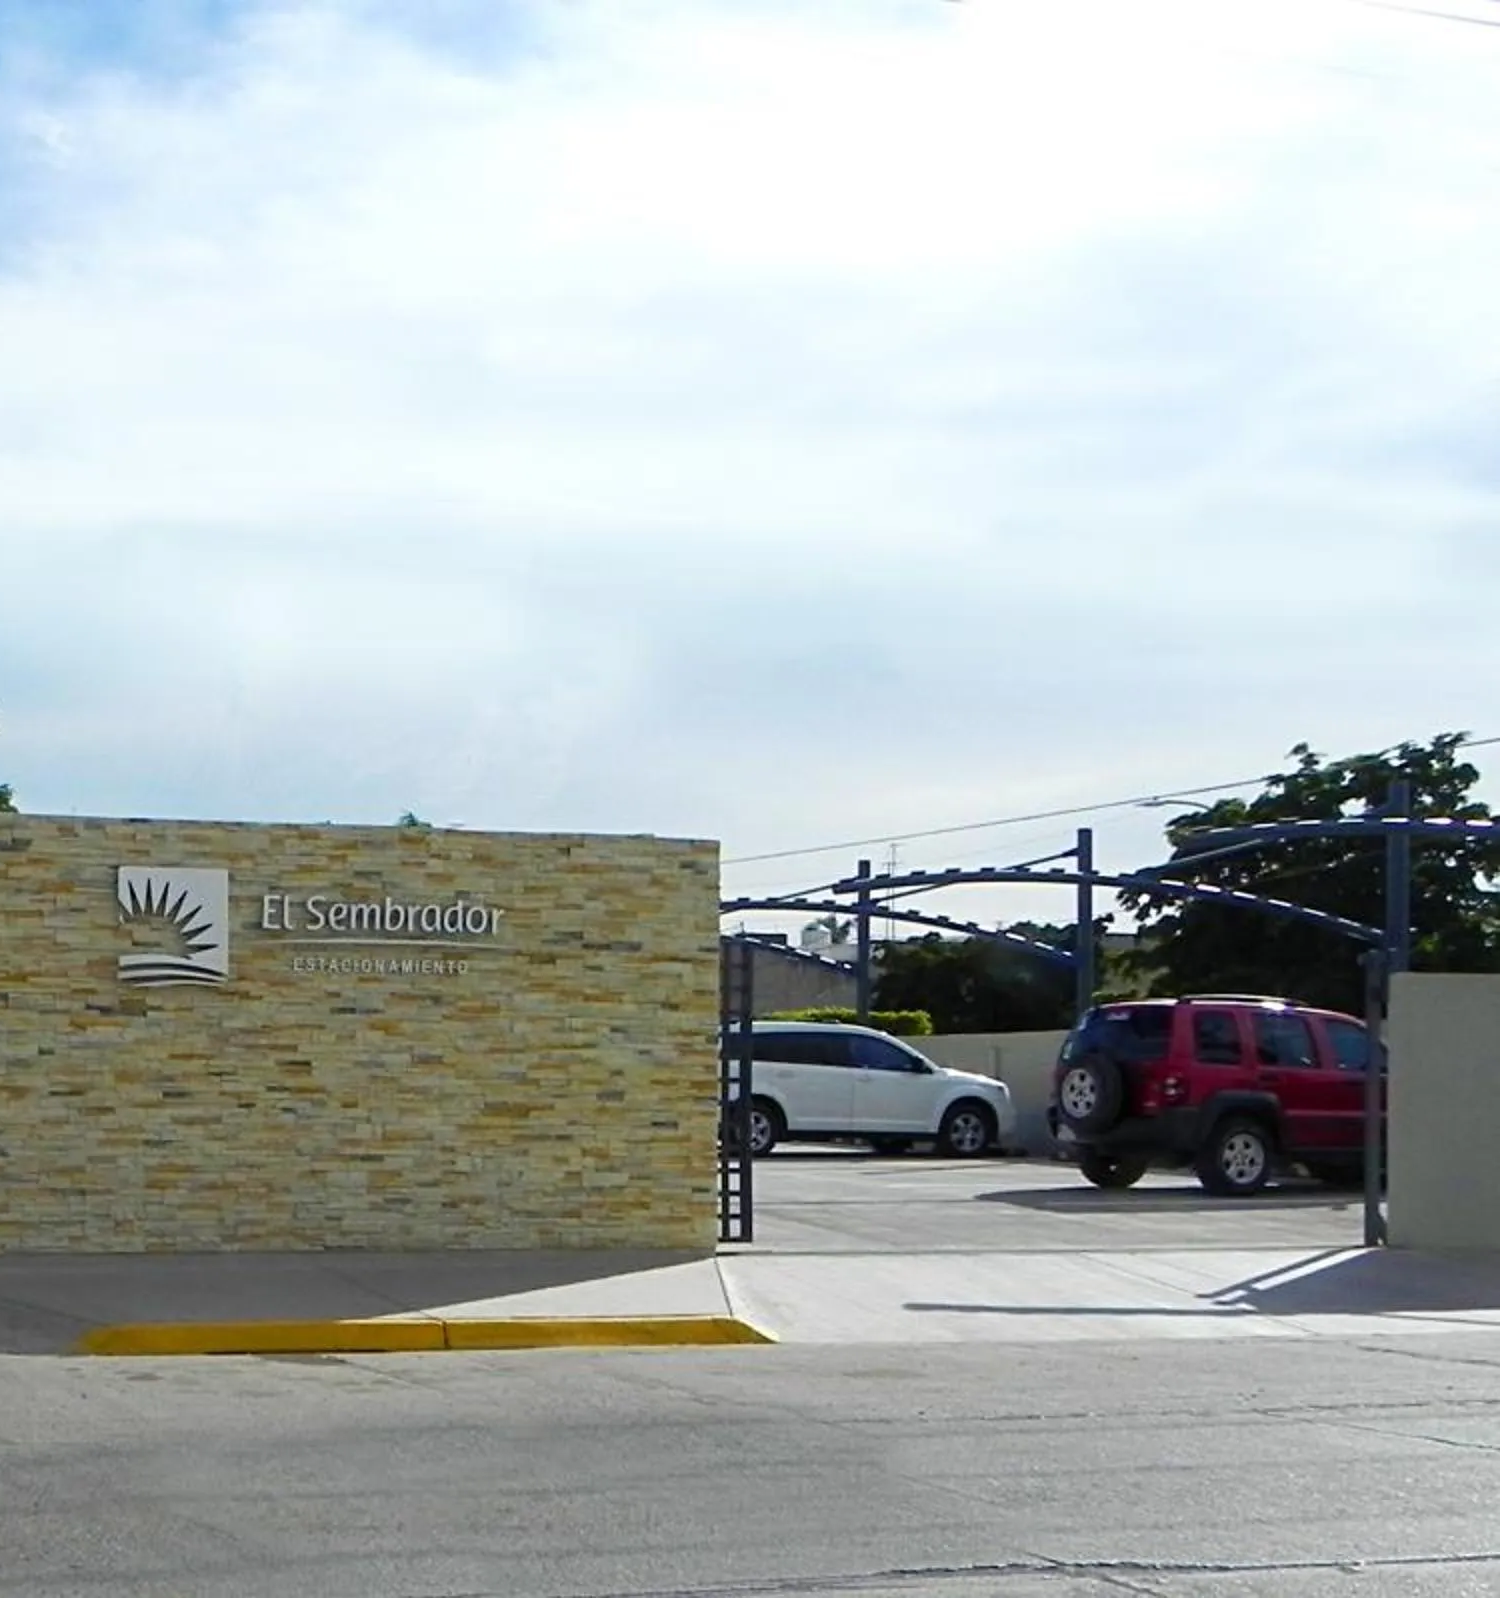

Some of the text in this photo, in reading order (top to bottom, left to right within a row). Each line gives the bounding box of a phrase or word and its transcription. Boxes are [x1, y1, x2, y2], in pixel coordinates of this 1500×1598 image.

[262, 895, 505, 935] El Sembrador
[293, 957, 469, 975] ESTACIONAMIENTO
